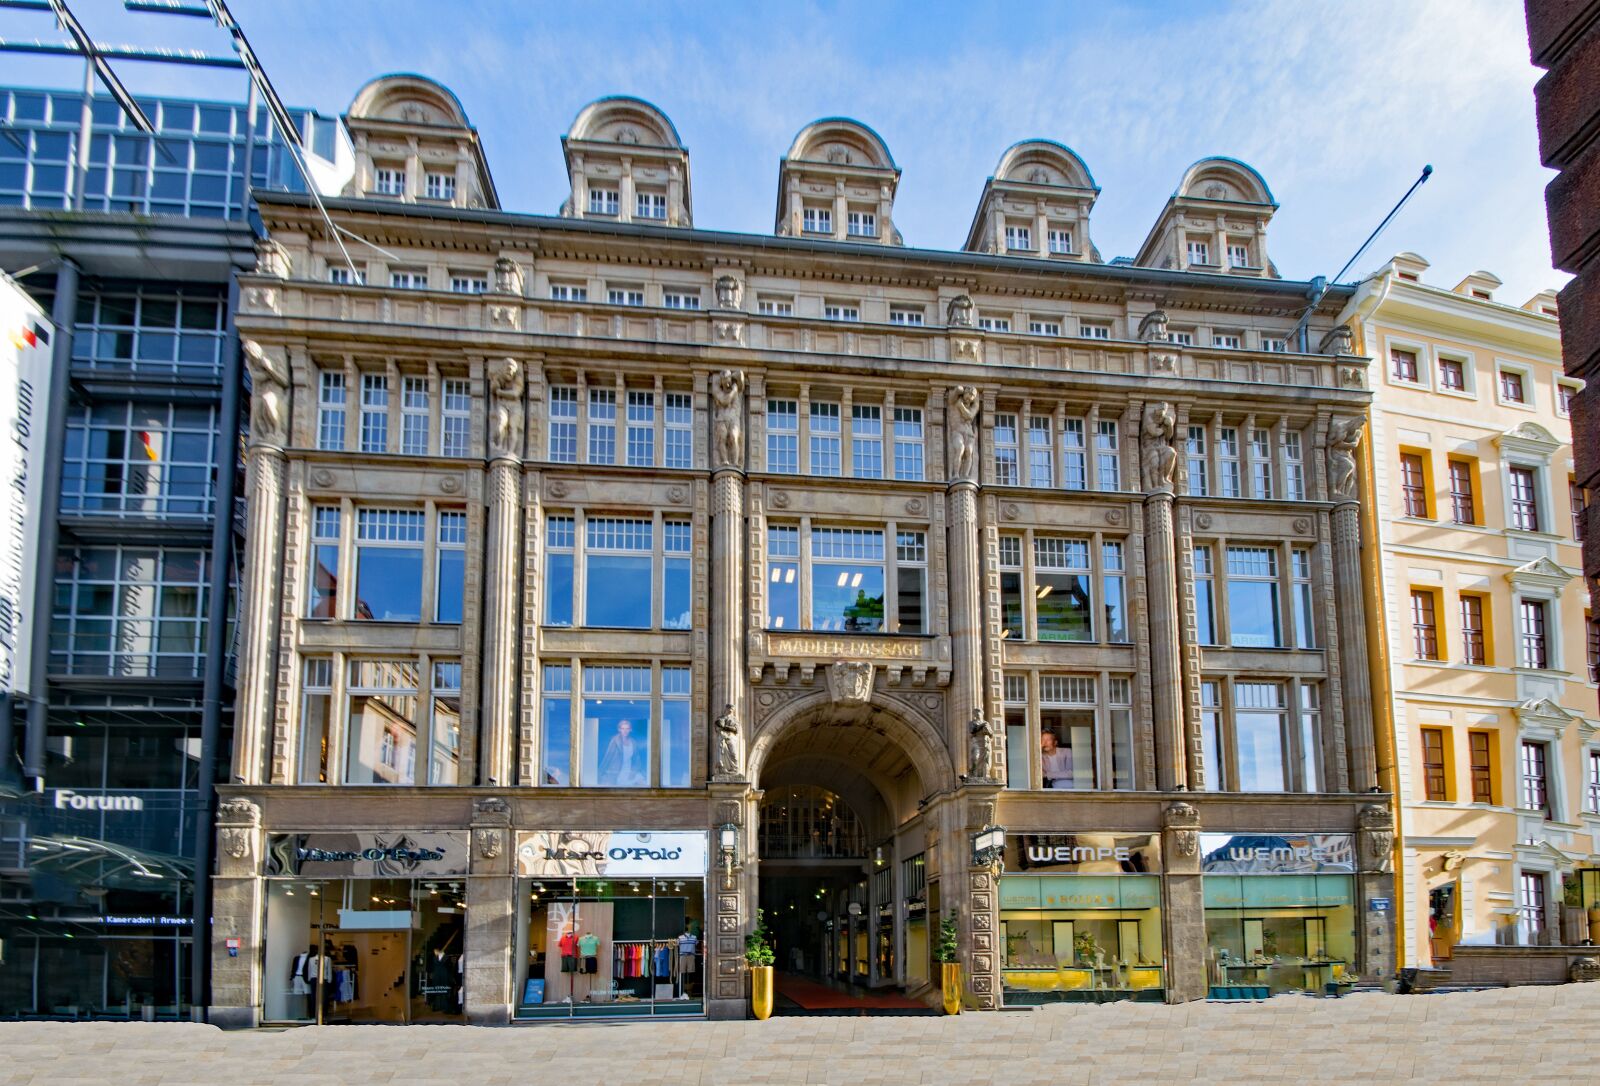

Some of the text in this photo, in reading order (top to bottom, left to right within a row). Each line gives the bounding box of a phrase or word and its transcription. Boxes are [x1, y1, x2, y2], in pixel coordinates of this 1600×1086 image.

[55, 789, 144, 811] Forum
[543, 847, 605, 861] Marc
[1028, 846, 1130, 861] WEMPE
[1229, 847, 1329, 861] WEMPE
[106, 915, 156, 924] Kameraden!
[160, 916, 187, 925] Armee
